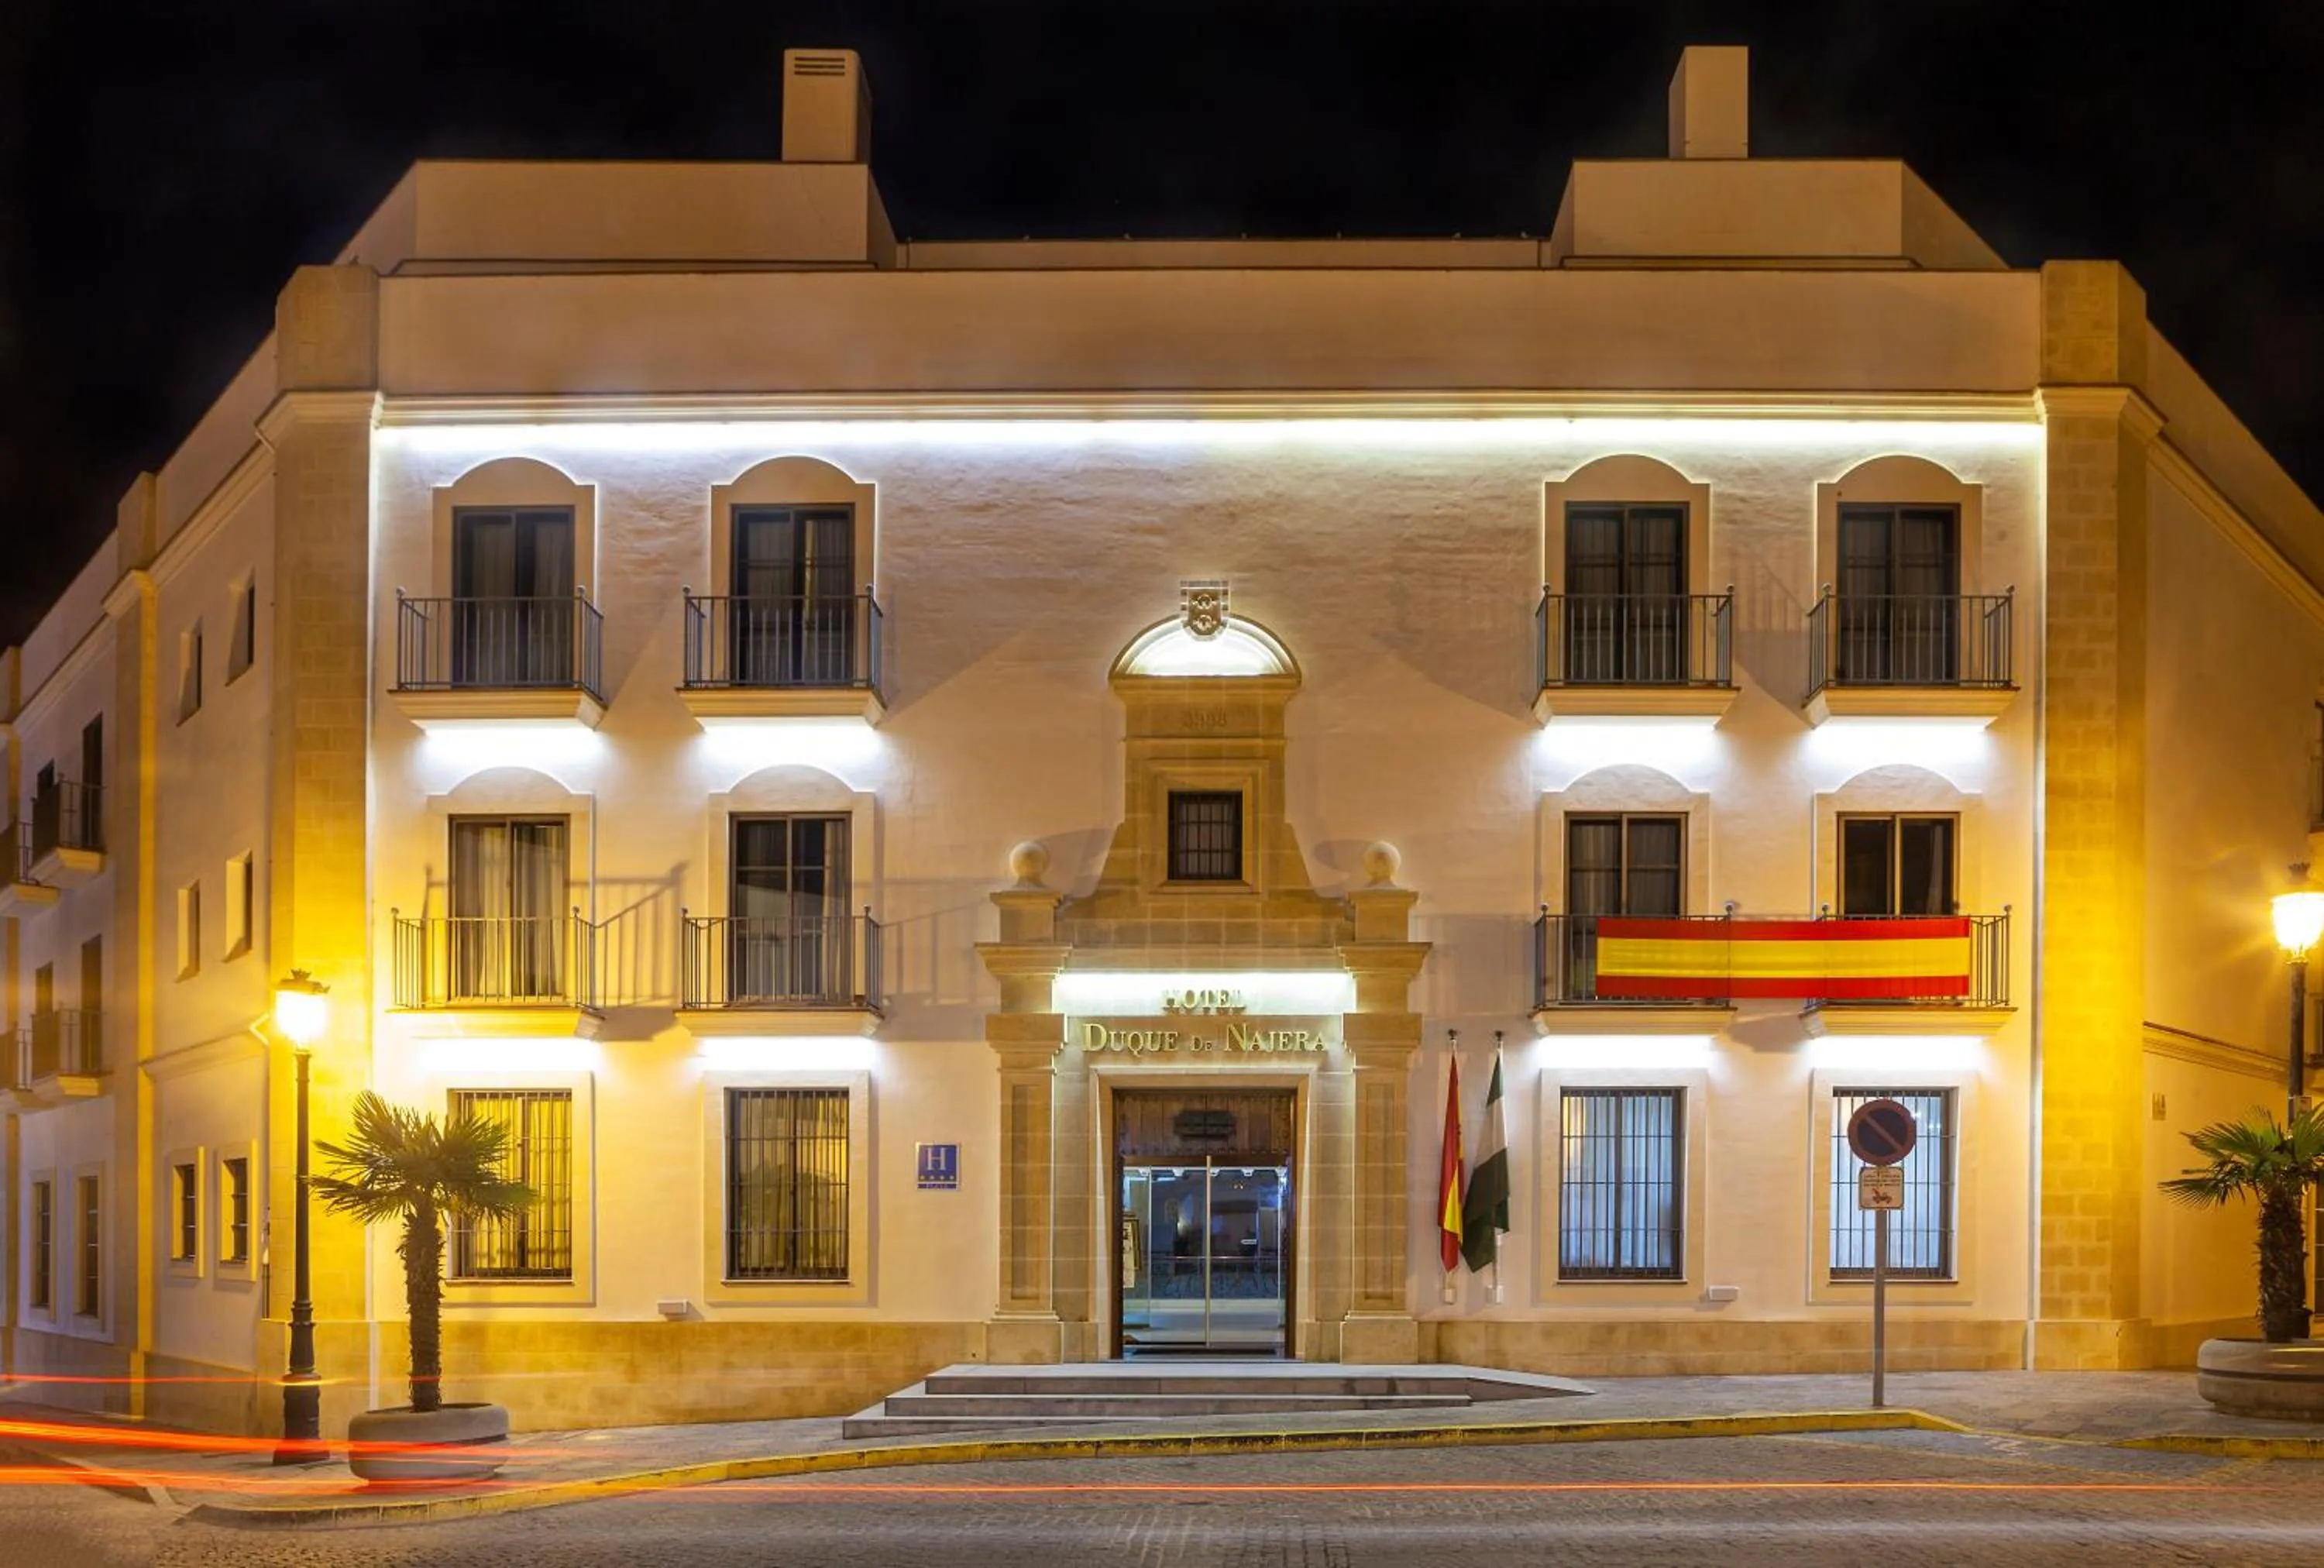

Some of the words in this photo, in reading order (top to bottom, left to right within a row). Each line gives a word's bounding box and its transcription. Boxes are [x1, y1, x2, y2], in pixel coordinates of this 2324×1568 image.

[1081, 1023, 1178, 1057] DUQUE
[1224, 1022, 1329, 1054] NAJERA
[926, 1147, 947, 1171] H
